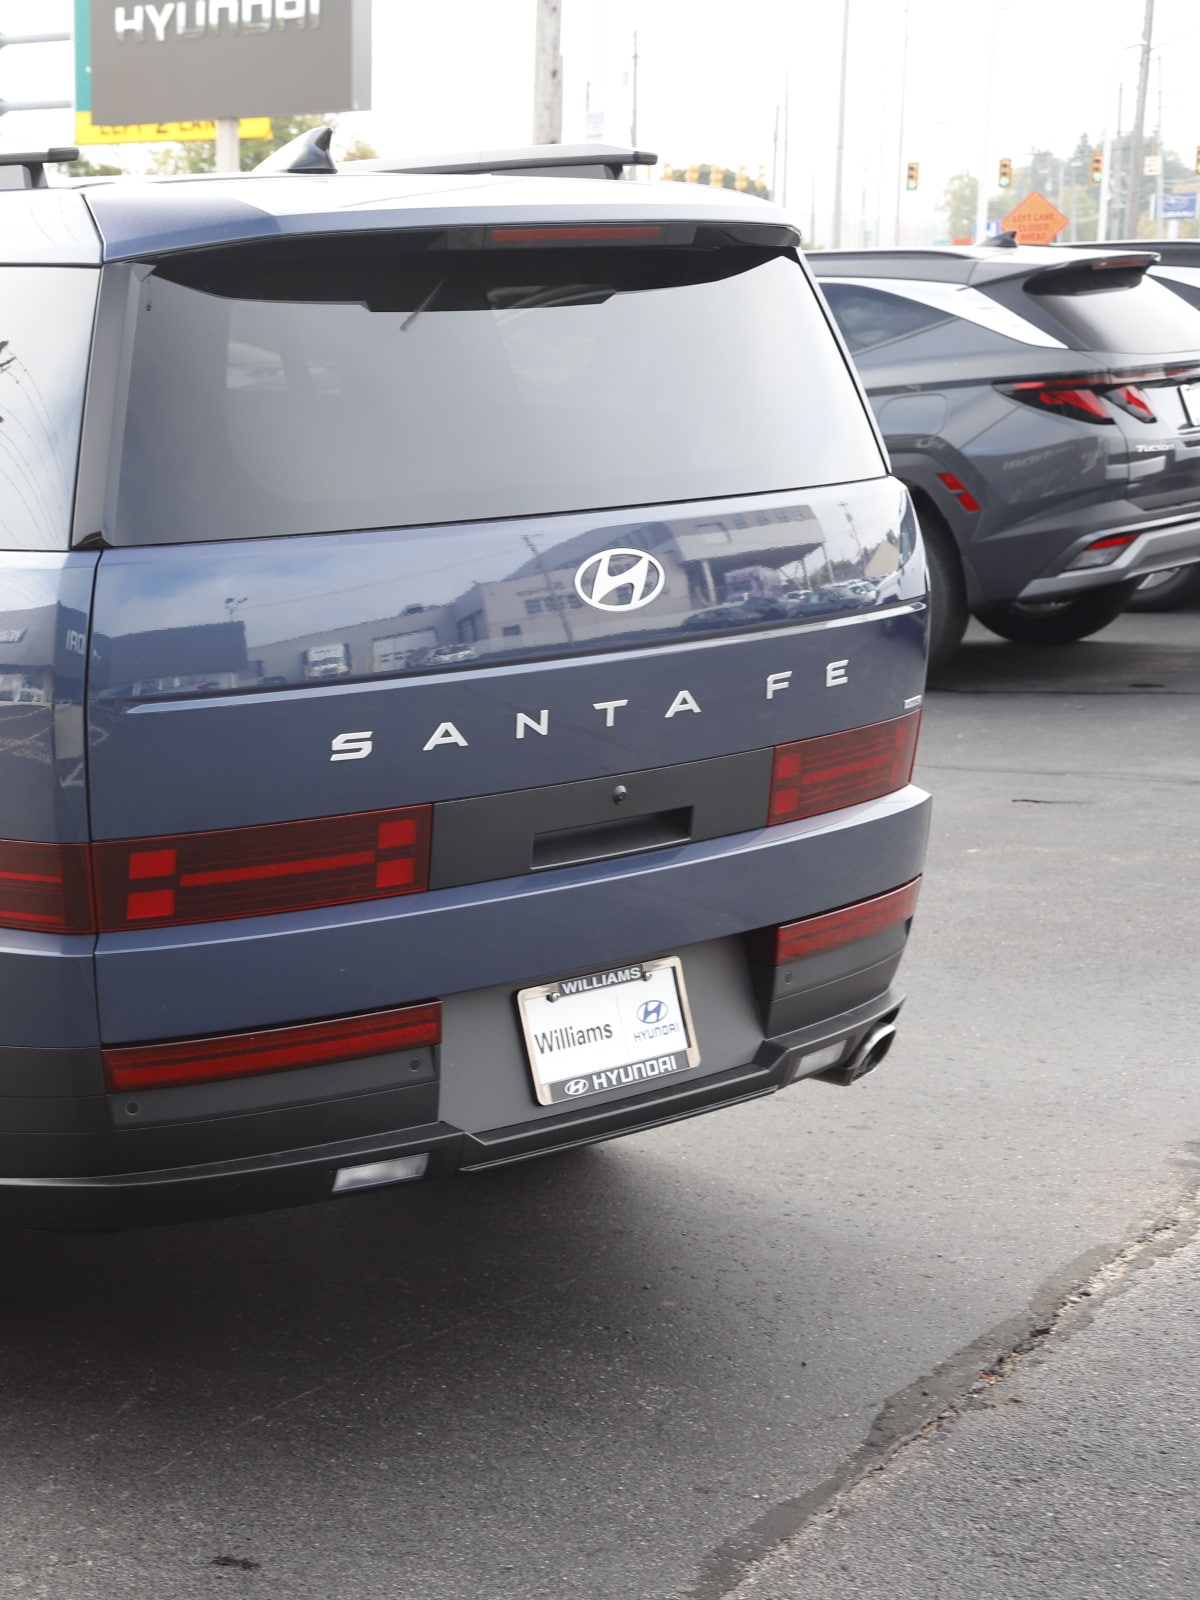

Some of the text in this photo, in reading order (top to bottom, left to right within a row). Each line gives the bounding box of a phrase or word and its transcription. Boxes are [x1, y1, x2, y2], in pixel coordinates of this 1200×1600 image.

[114, 0, 321, 43] HYUNDAI
[329, 658, 850, 762] SANTA FE
[560, 966, 642, 996] WILLIAMS
[533, 1022, 614, 1055] Williams
[632, 1022, 680, 1043] HYUNDAI
[592, 1054, 678, 1091] HYUNDAI
